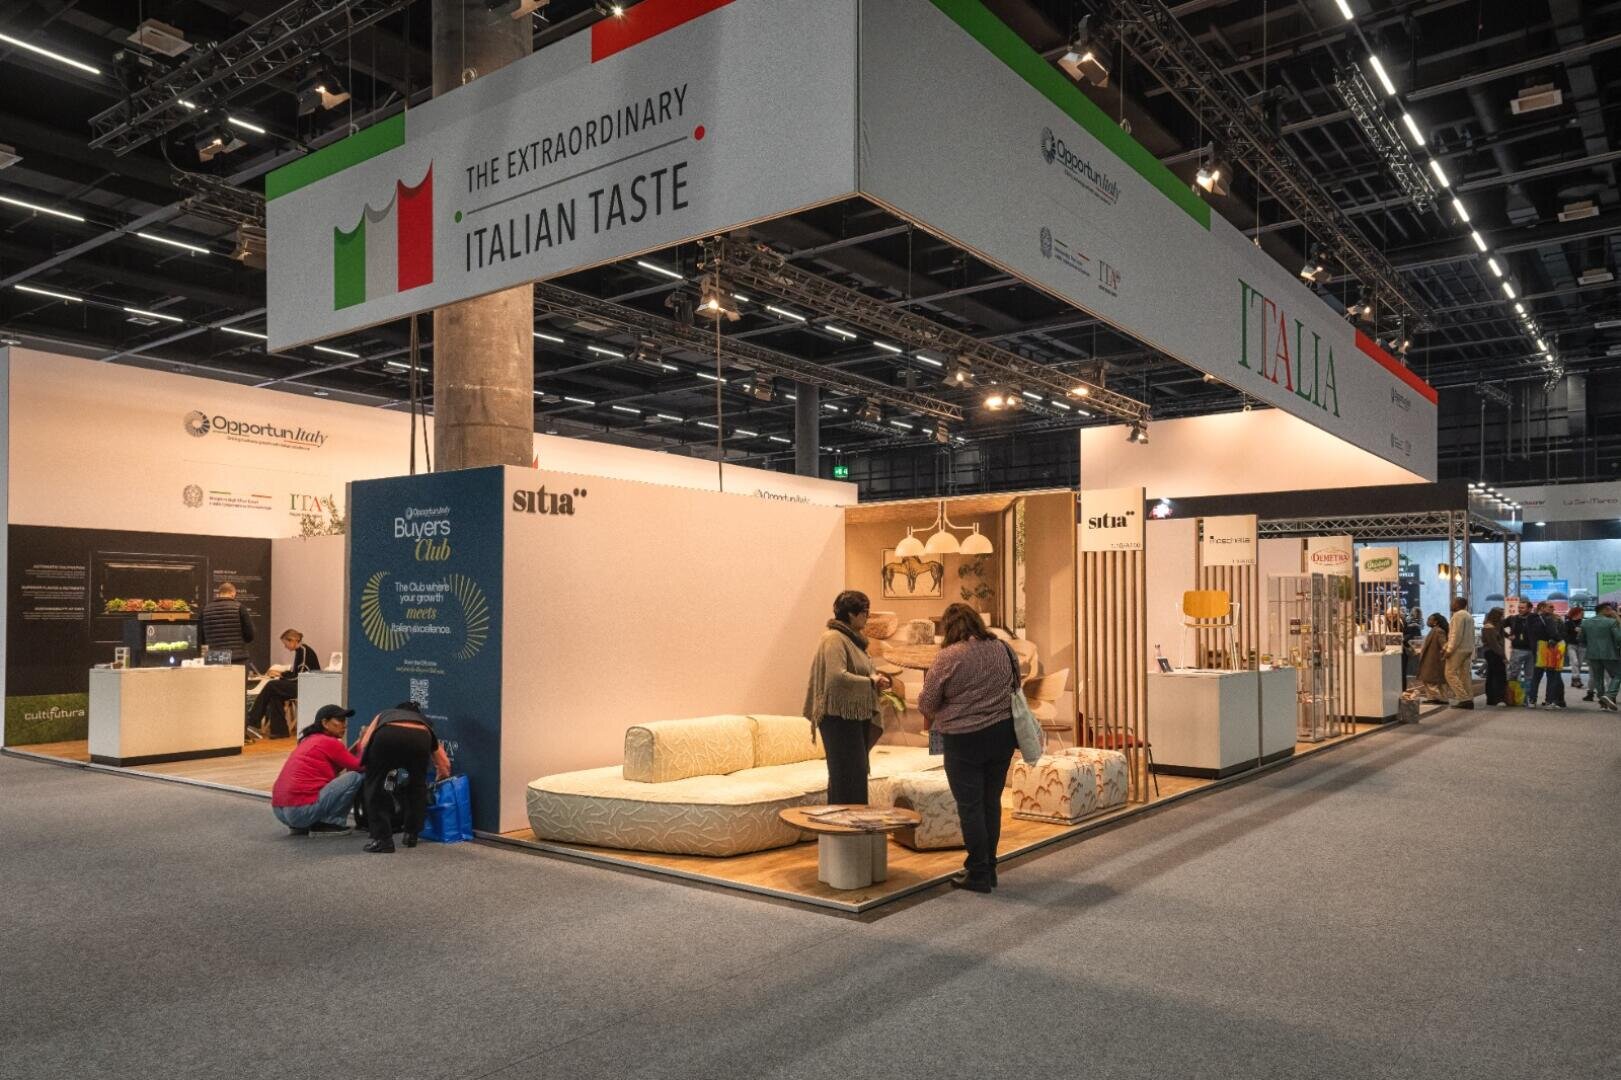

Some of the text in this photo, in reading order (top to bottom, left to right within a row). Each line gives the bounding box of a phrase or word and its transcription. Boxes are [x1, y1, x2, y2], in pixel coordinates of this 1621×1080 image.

[466, 83, 688, 193] THE EXTRAORDINARY
[466, 161, 689, 272] ITALIAN TASTE
[1238, 278, 1340, 417] ITALIA
[394, 517, 451, 542] Buyers
[415, 537, 451, 561] Club
[395, 581, 408, 592] The
[409, 581, 425, 592] Club
[400, 594, 416, 604] your
[406, 608, 437, 620] meets
